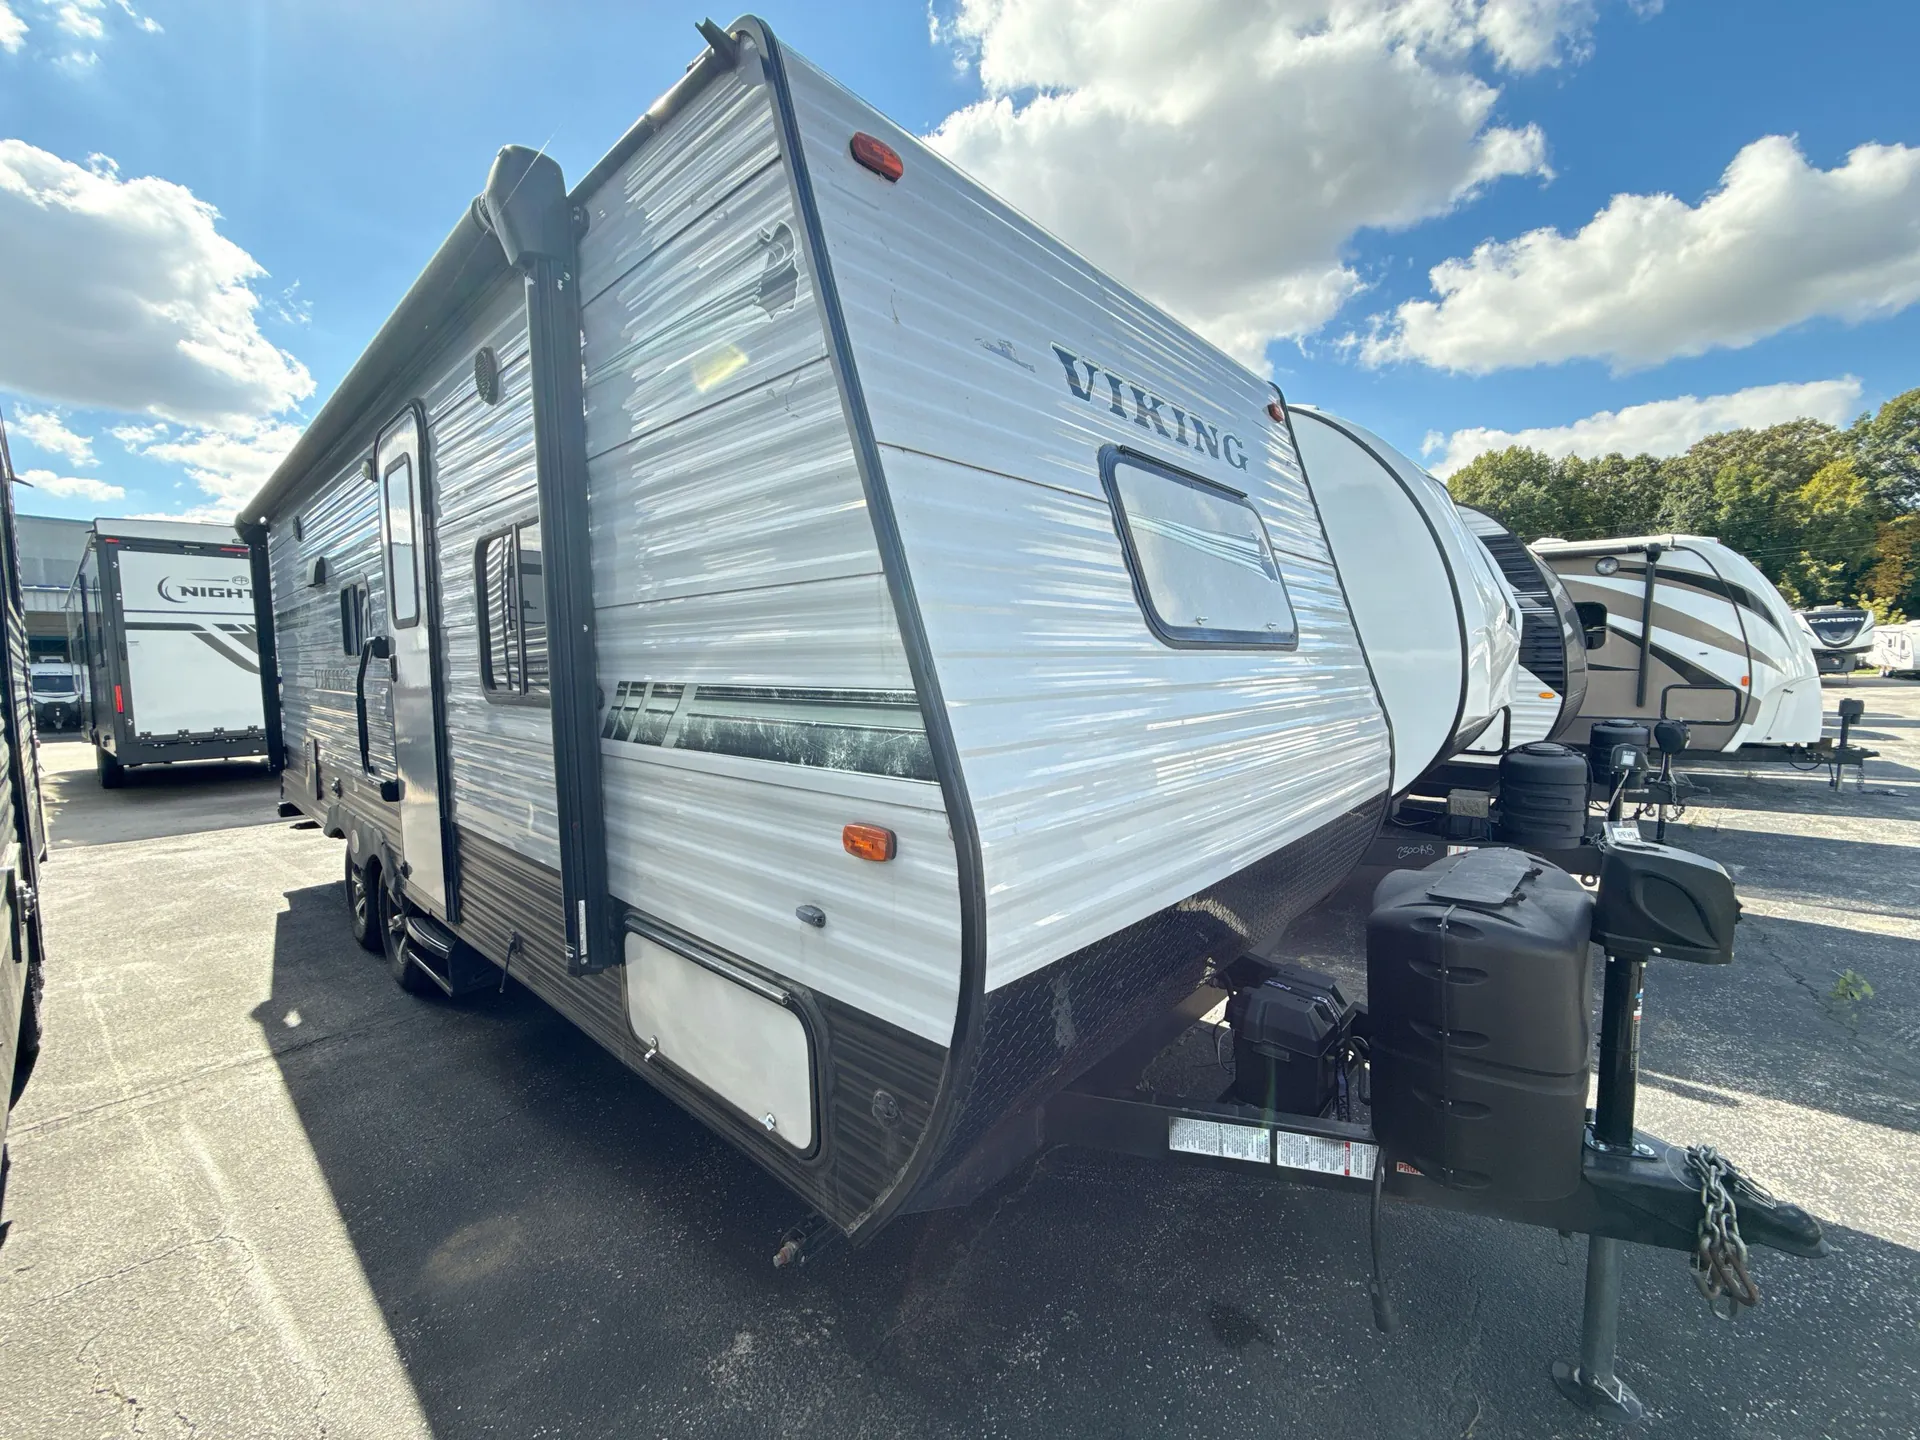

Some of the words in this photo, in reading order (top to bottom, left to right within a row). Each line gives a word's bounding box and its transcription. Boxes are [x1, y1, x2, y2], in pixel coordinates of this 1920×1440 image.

[1051, 341, 1249, 473] VIKING
[1808, 616, 1864, 624] CARBON
[315, 668, 350, 690] VIKING
